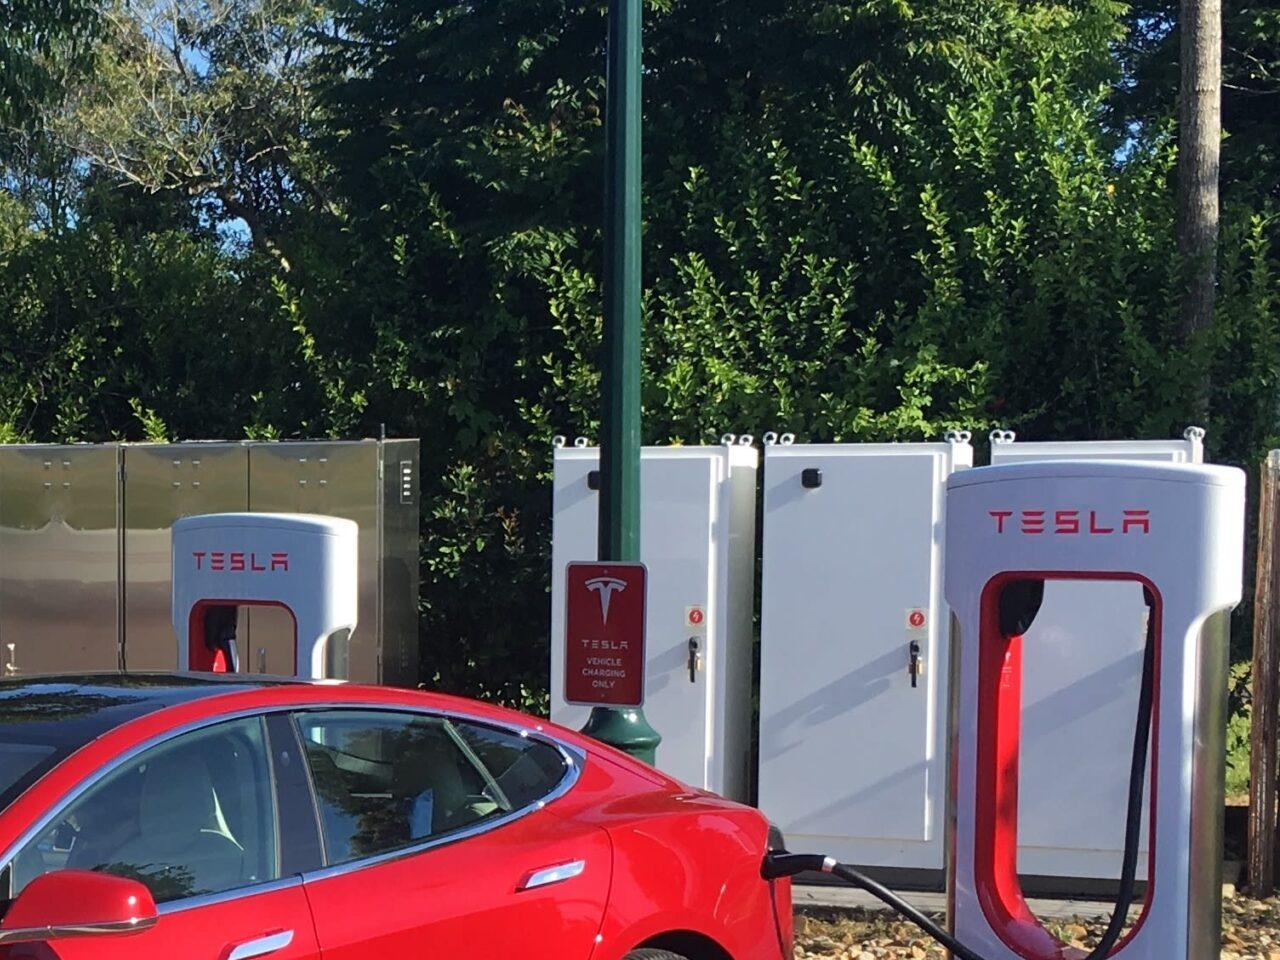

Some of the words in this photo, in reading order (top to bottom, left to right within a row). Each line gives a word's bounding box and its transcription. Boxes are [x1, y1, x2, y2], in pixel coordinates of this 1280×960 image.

[989, 510, 1150, 534] TESLA
[192, 552, 288, 571] TESLA
[581, 639, 628, 649] TESLA
[586, 657, 622, 666] VEHICLE
[582, 668, 626, 678] CHARGING
[592, 680, 616, 688] ONLY
